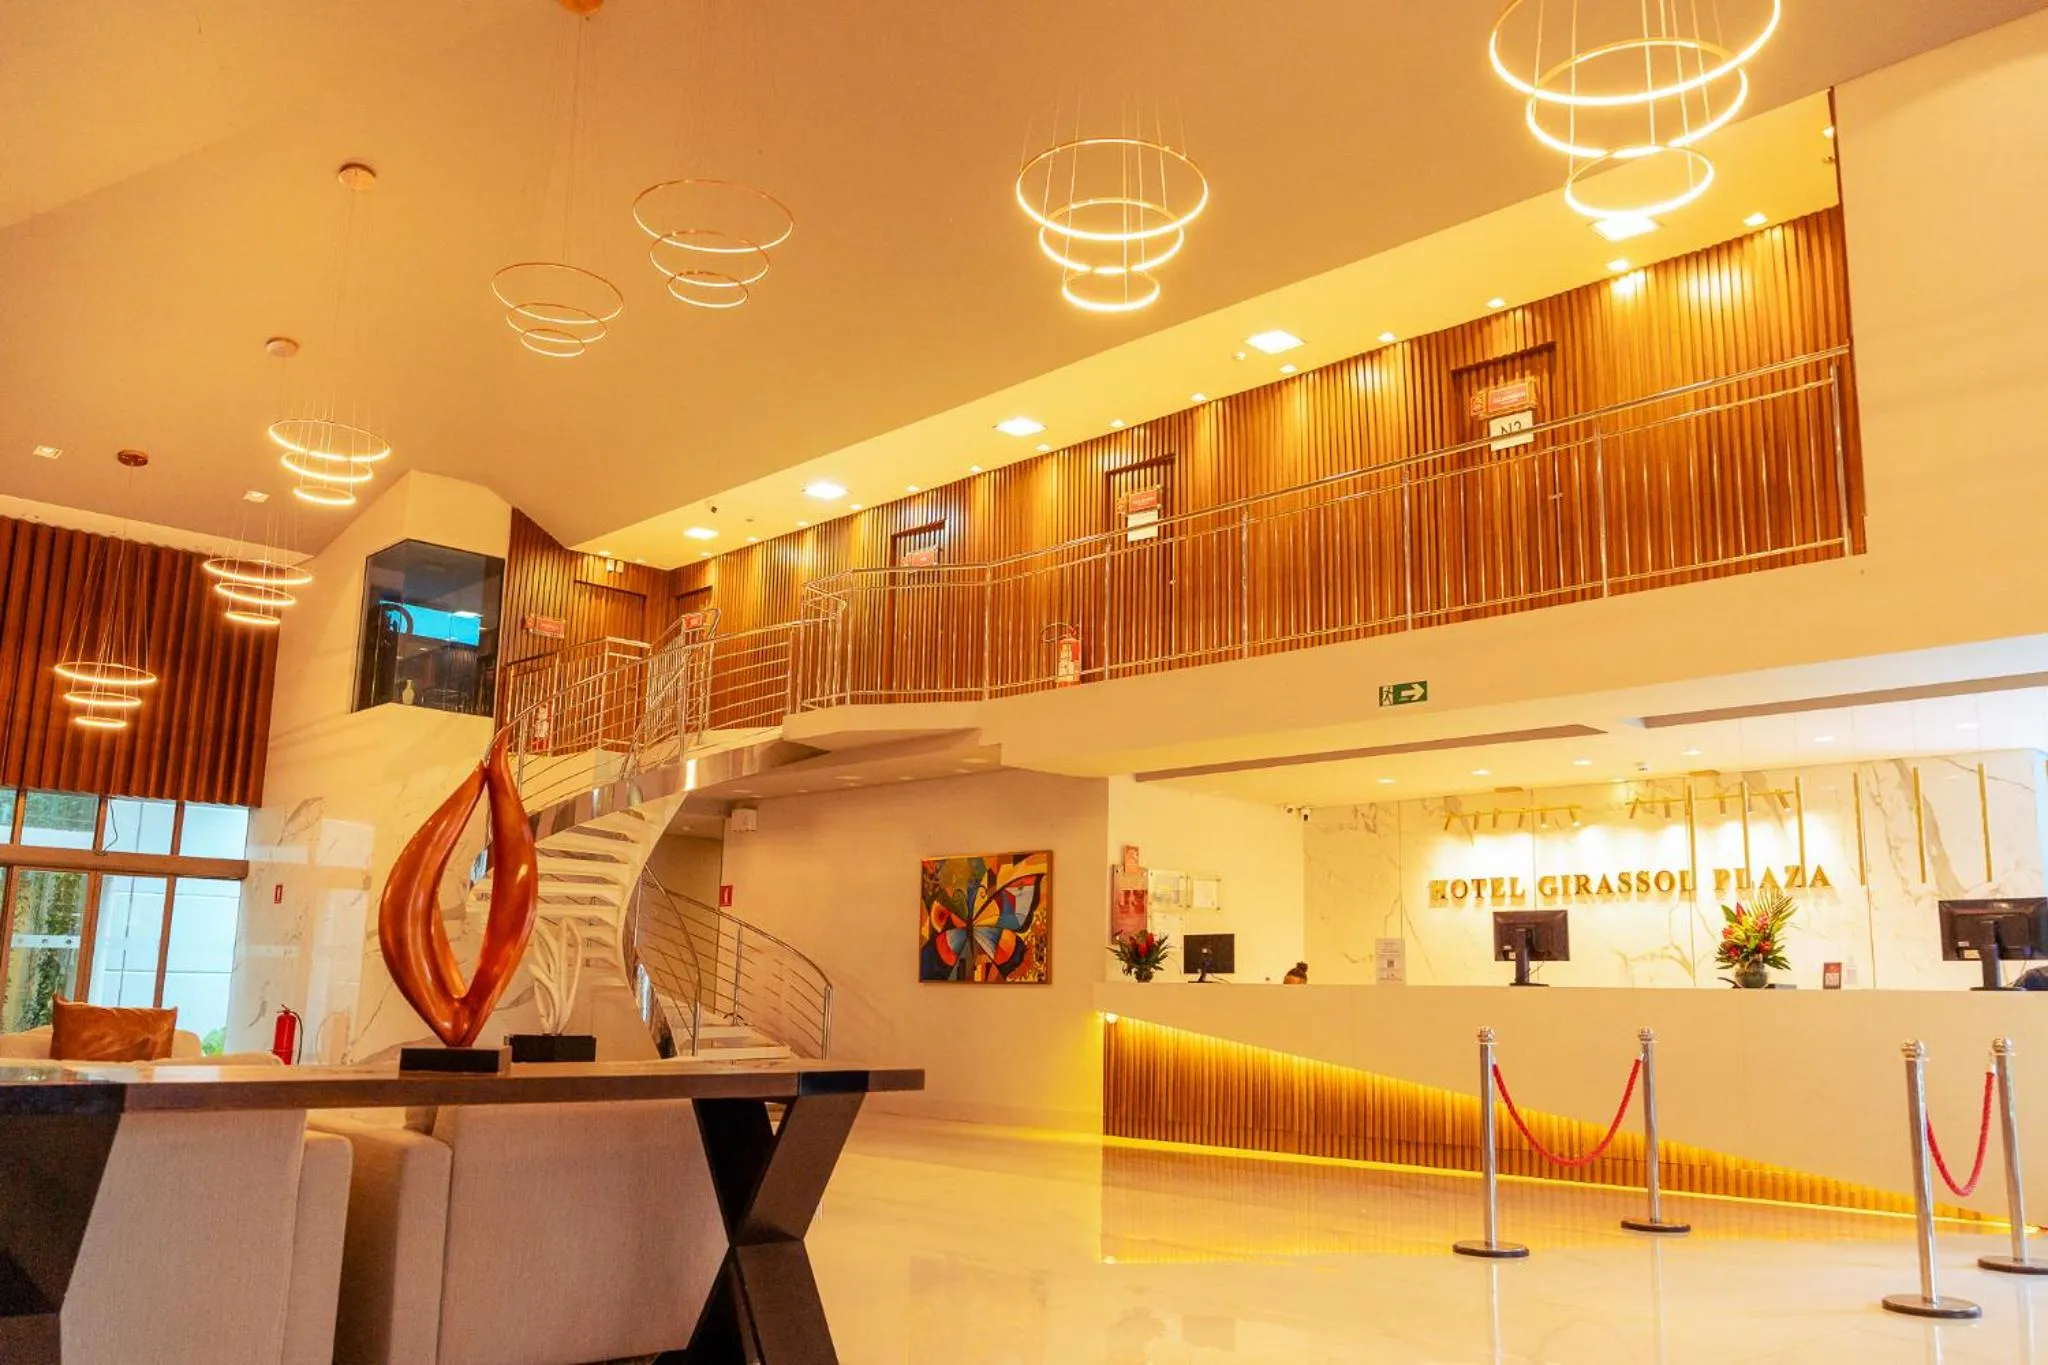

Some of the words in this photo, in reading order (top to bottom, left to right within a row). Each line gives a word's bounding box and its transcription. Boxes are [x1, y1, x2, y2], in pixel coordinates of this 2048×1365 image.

[1428, 877, 1525, 901] HOTEL
[1538, 869, 1696, 897] GIRASSOL
[1713, 864, 1831, 891] PLAZA
